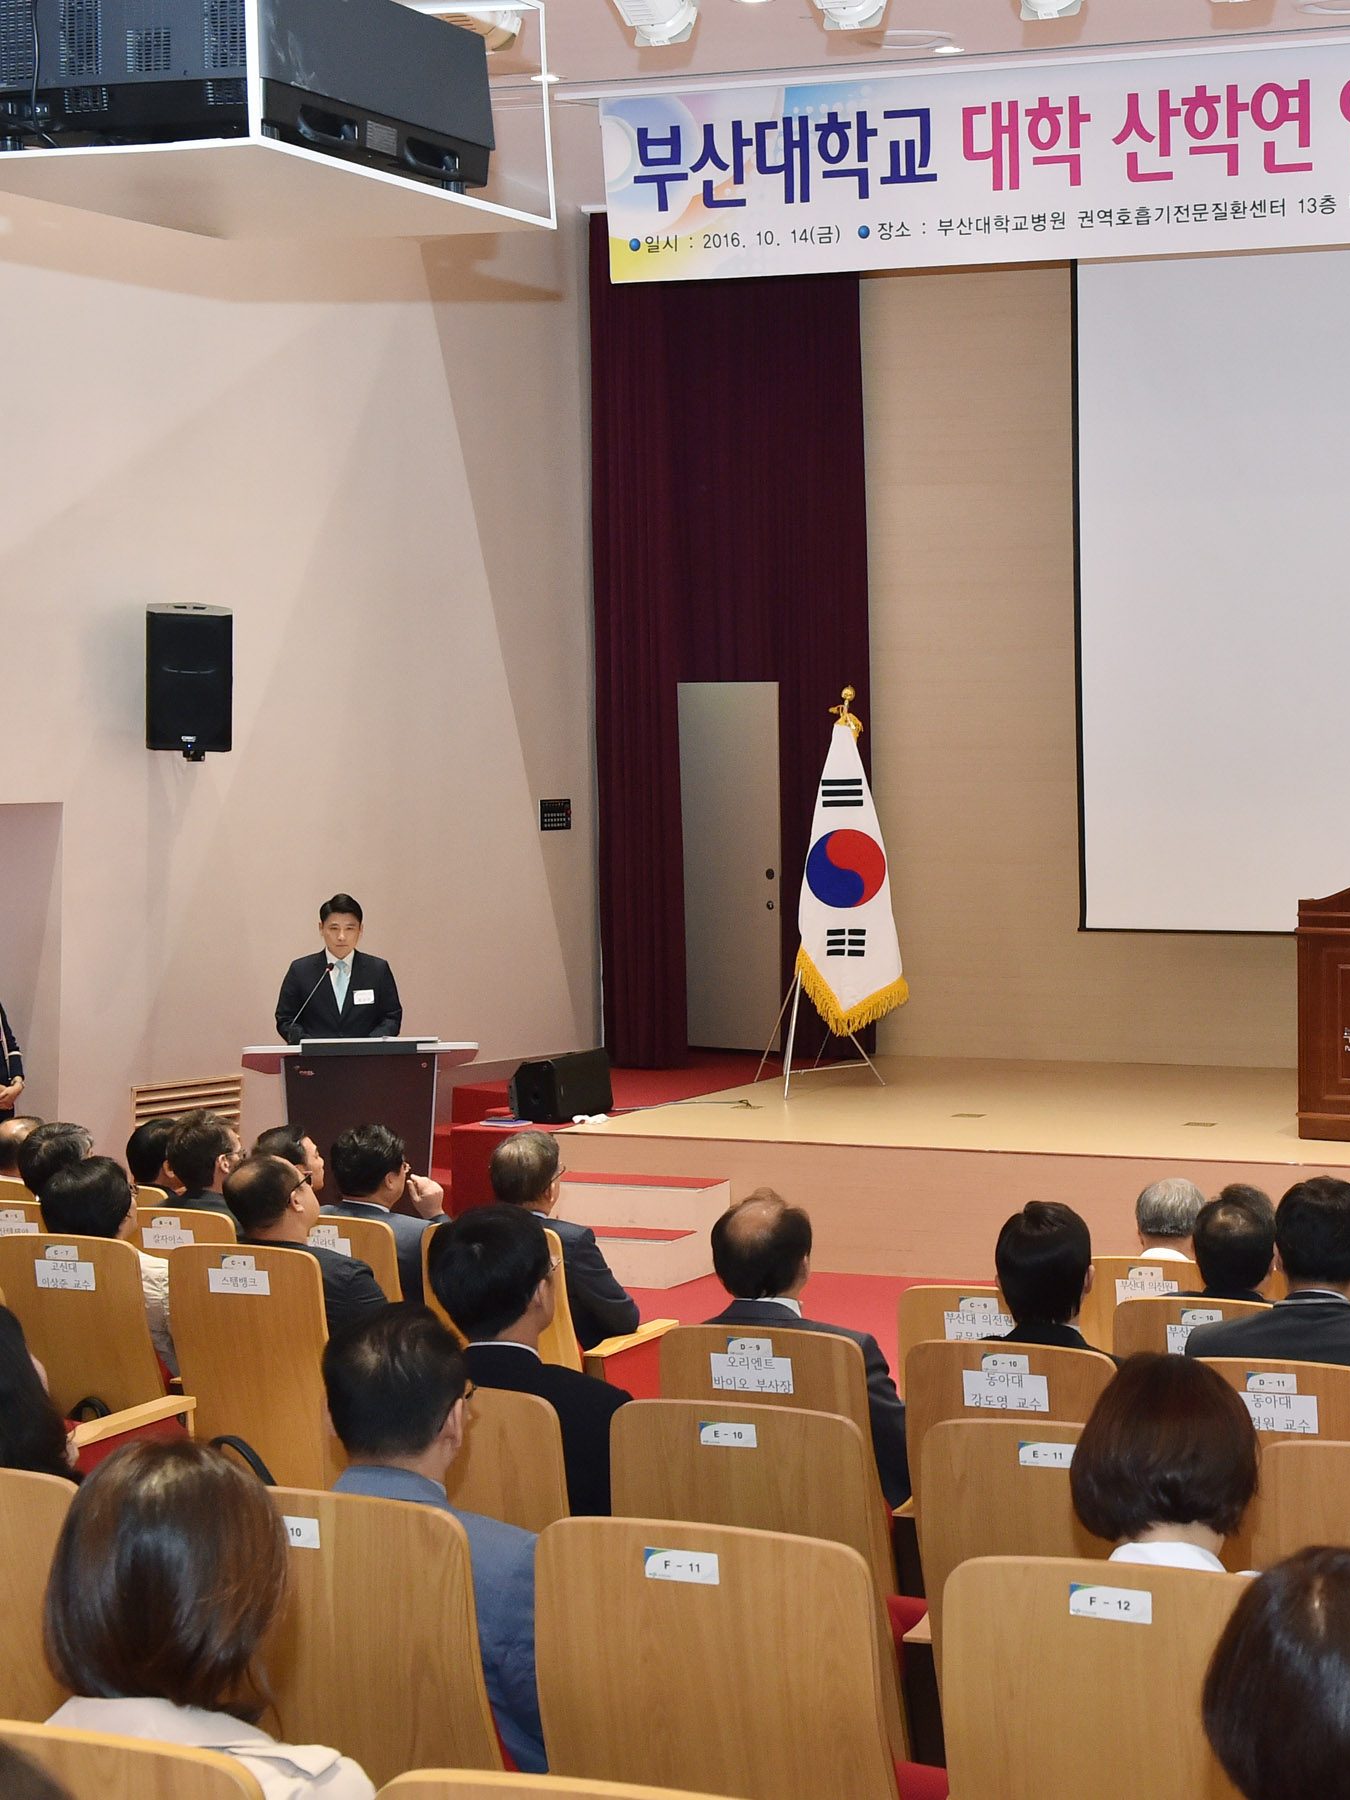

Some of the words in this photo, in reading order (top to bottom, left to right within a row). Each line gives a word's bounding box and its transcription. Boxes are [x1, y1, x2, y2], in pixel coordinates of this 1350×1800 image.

[634, 109, 937, 211] 부산대학교
[963, 96, 1090, 190] 대학
[1114, 80, 1312, 182] 산학연
[877, 221, 911, 240] 장소
[937, 211, 1066, 237] 부산대학교병원
[1077, 198, 1287, 229] 권역호흡기전문질환센터
[1298, 194, 1338, 216] 13층
[645, 235, 678, 253] 일시
[703, 233, 746, 249] 2016.
[757, 231, 781, 247] 10.
[791, 225, 841, 246] 14(금)
[51, 1261, 77, 1273] 고신대
[74, 1279, 91, 1290] 교수
[1120, 1280, 1145, 1291] 부산대
[946, 1312, 976, 1325] 부산대
[982, 1314, 1013, 1327] 의전원
[1168, 1326, 1191, 1339] 부산
[726, 1356, 775, 1370] 오리엔트
[714, 1376, 750, 1390] 바이오
[756, 1379, 792, 1393] 부사장
[986, 1372, 1023, 1388] 동아대
[971, 1393, 1008, 1410] 강도영
[1016, 1396, 1042, 1412] 교수
[1251, 1394, 1292, 1409] 동아대
[1284, 1419, 1311, 1433] 교수
[714, 1430, 720, 1438] E
[733, 1431, 742, 1440] 10
[1032, 1450, 1038, 1458] E
[1054, 1452, 1063, 1460] 11
[290, 1527, 302, 1537] 10
[664, 1560, 670, 1570] F
[689, 1562, 700, 1572] 11
[1089, 1596, 1096, 1606] F
[1117, 1600, 1130, 1610] 12
